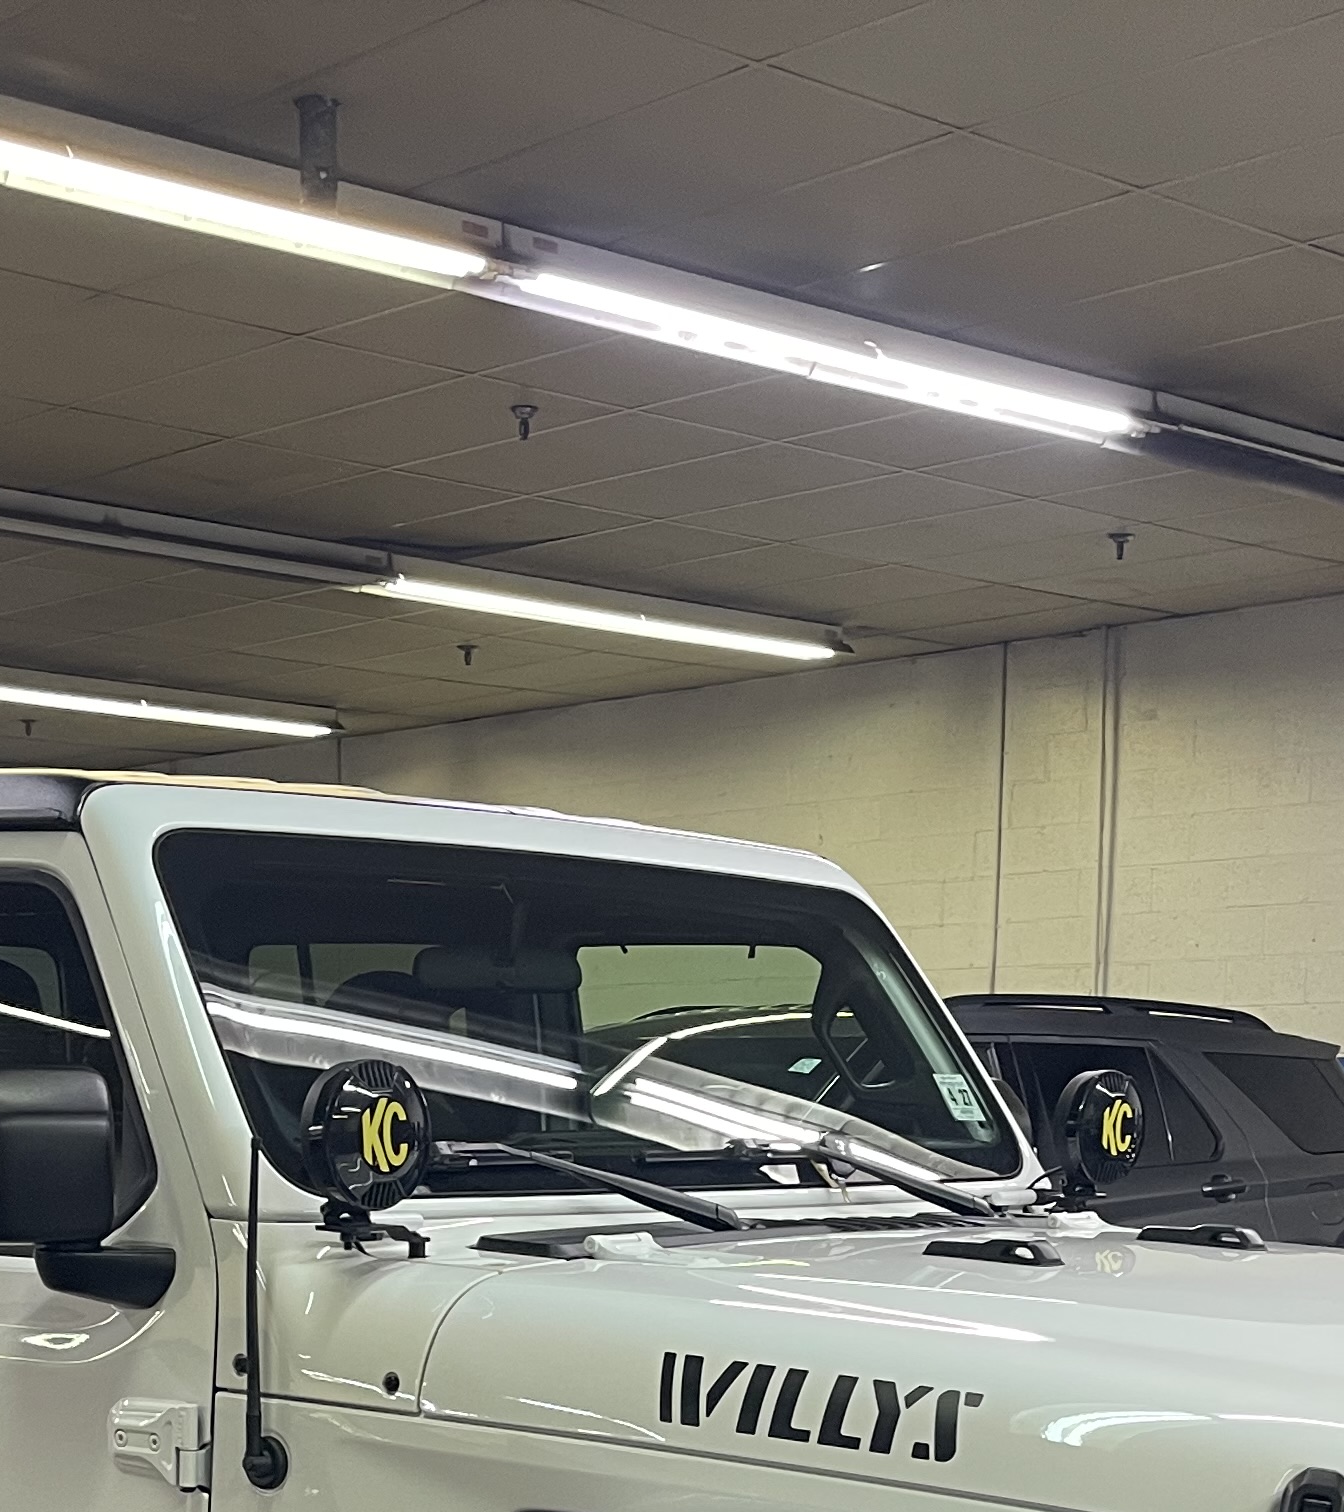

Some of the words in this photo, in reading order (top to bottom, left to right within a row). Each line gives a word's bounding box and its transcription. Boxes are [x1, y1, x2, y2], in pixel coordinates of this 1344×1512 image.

[361, 1096, 409, 1173] KC
[1101, 1098, 1134, 1157] KC
[659, 1351, 985, 1463] WILLYS
